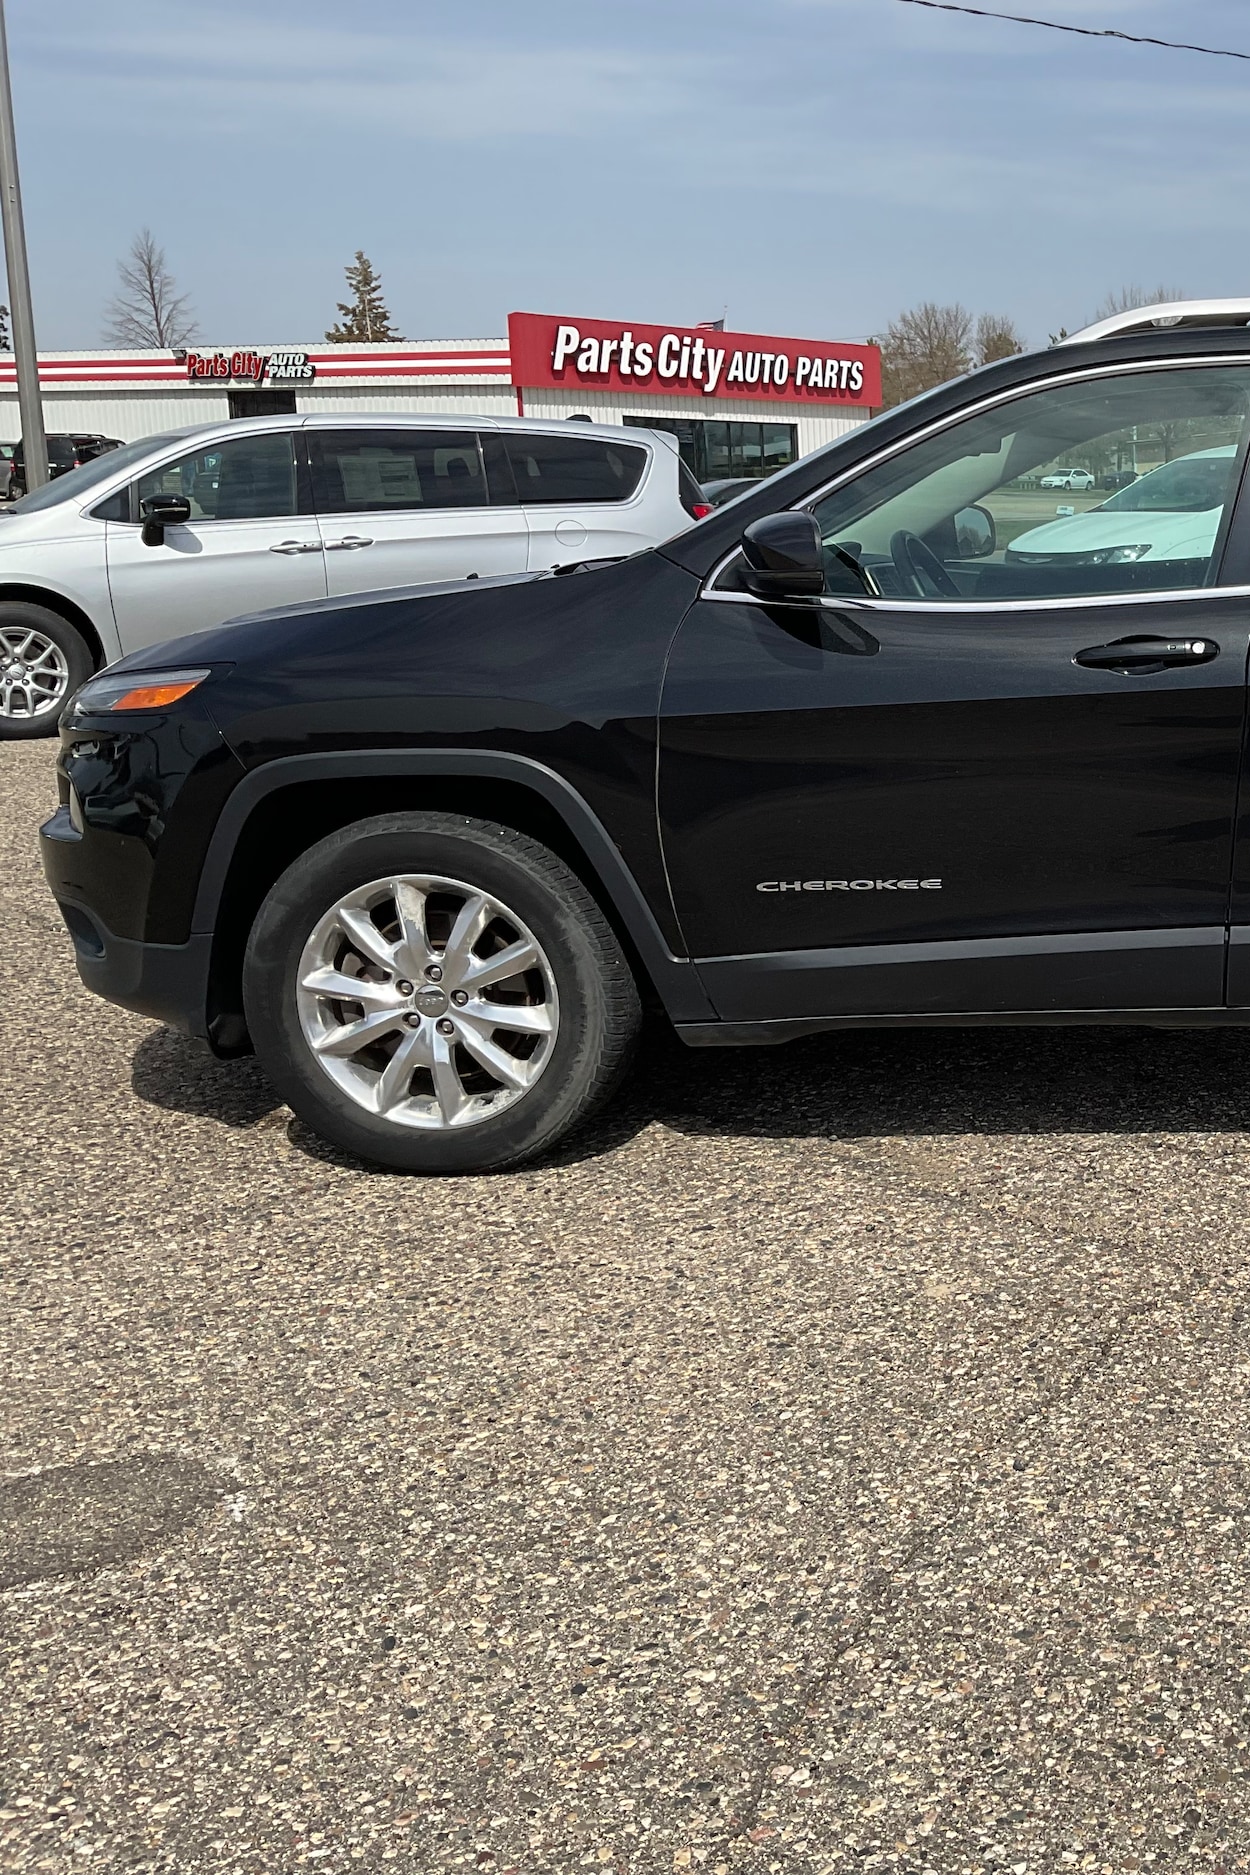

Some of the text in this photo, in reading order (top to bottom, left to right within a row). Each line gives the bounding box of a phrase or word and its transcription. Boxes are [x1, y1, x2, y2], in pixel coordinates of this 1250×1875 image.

[186, 351, 263, 381] Parts City
[268, 353, 305, 366] AUTO
[553, 325, 864, 393] Parts City AUTO PARTS
[268, 365, 314, 378] PARTS
[755, 878, 943, 892] CHEROKEE
